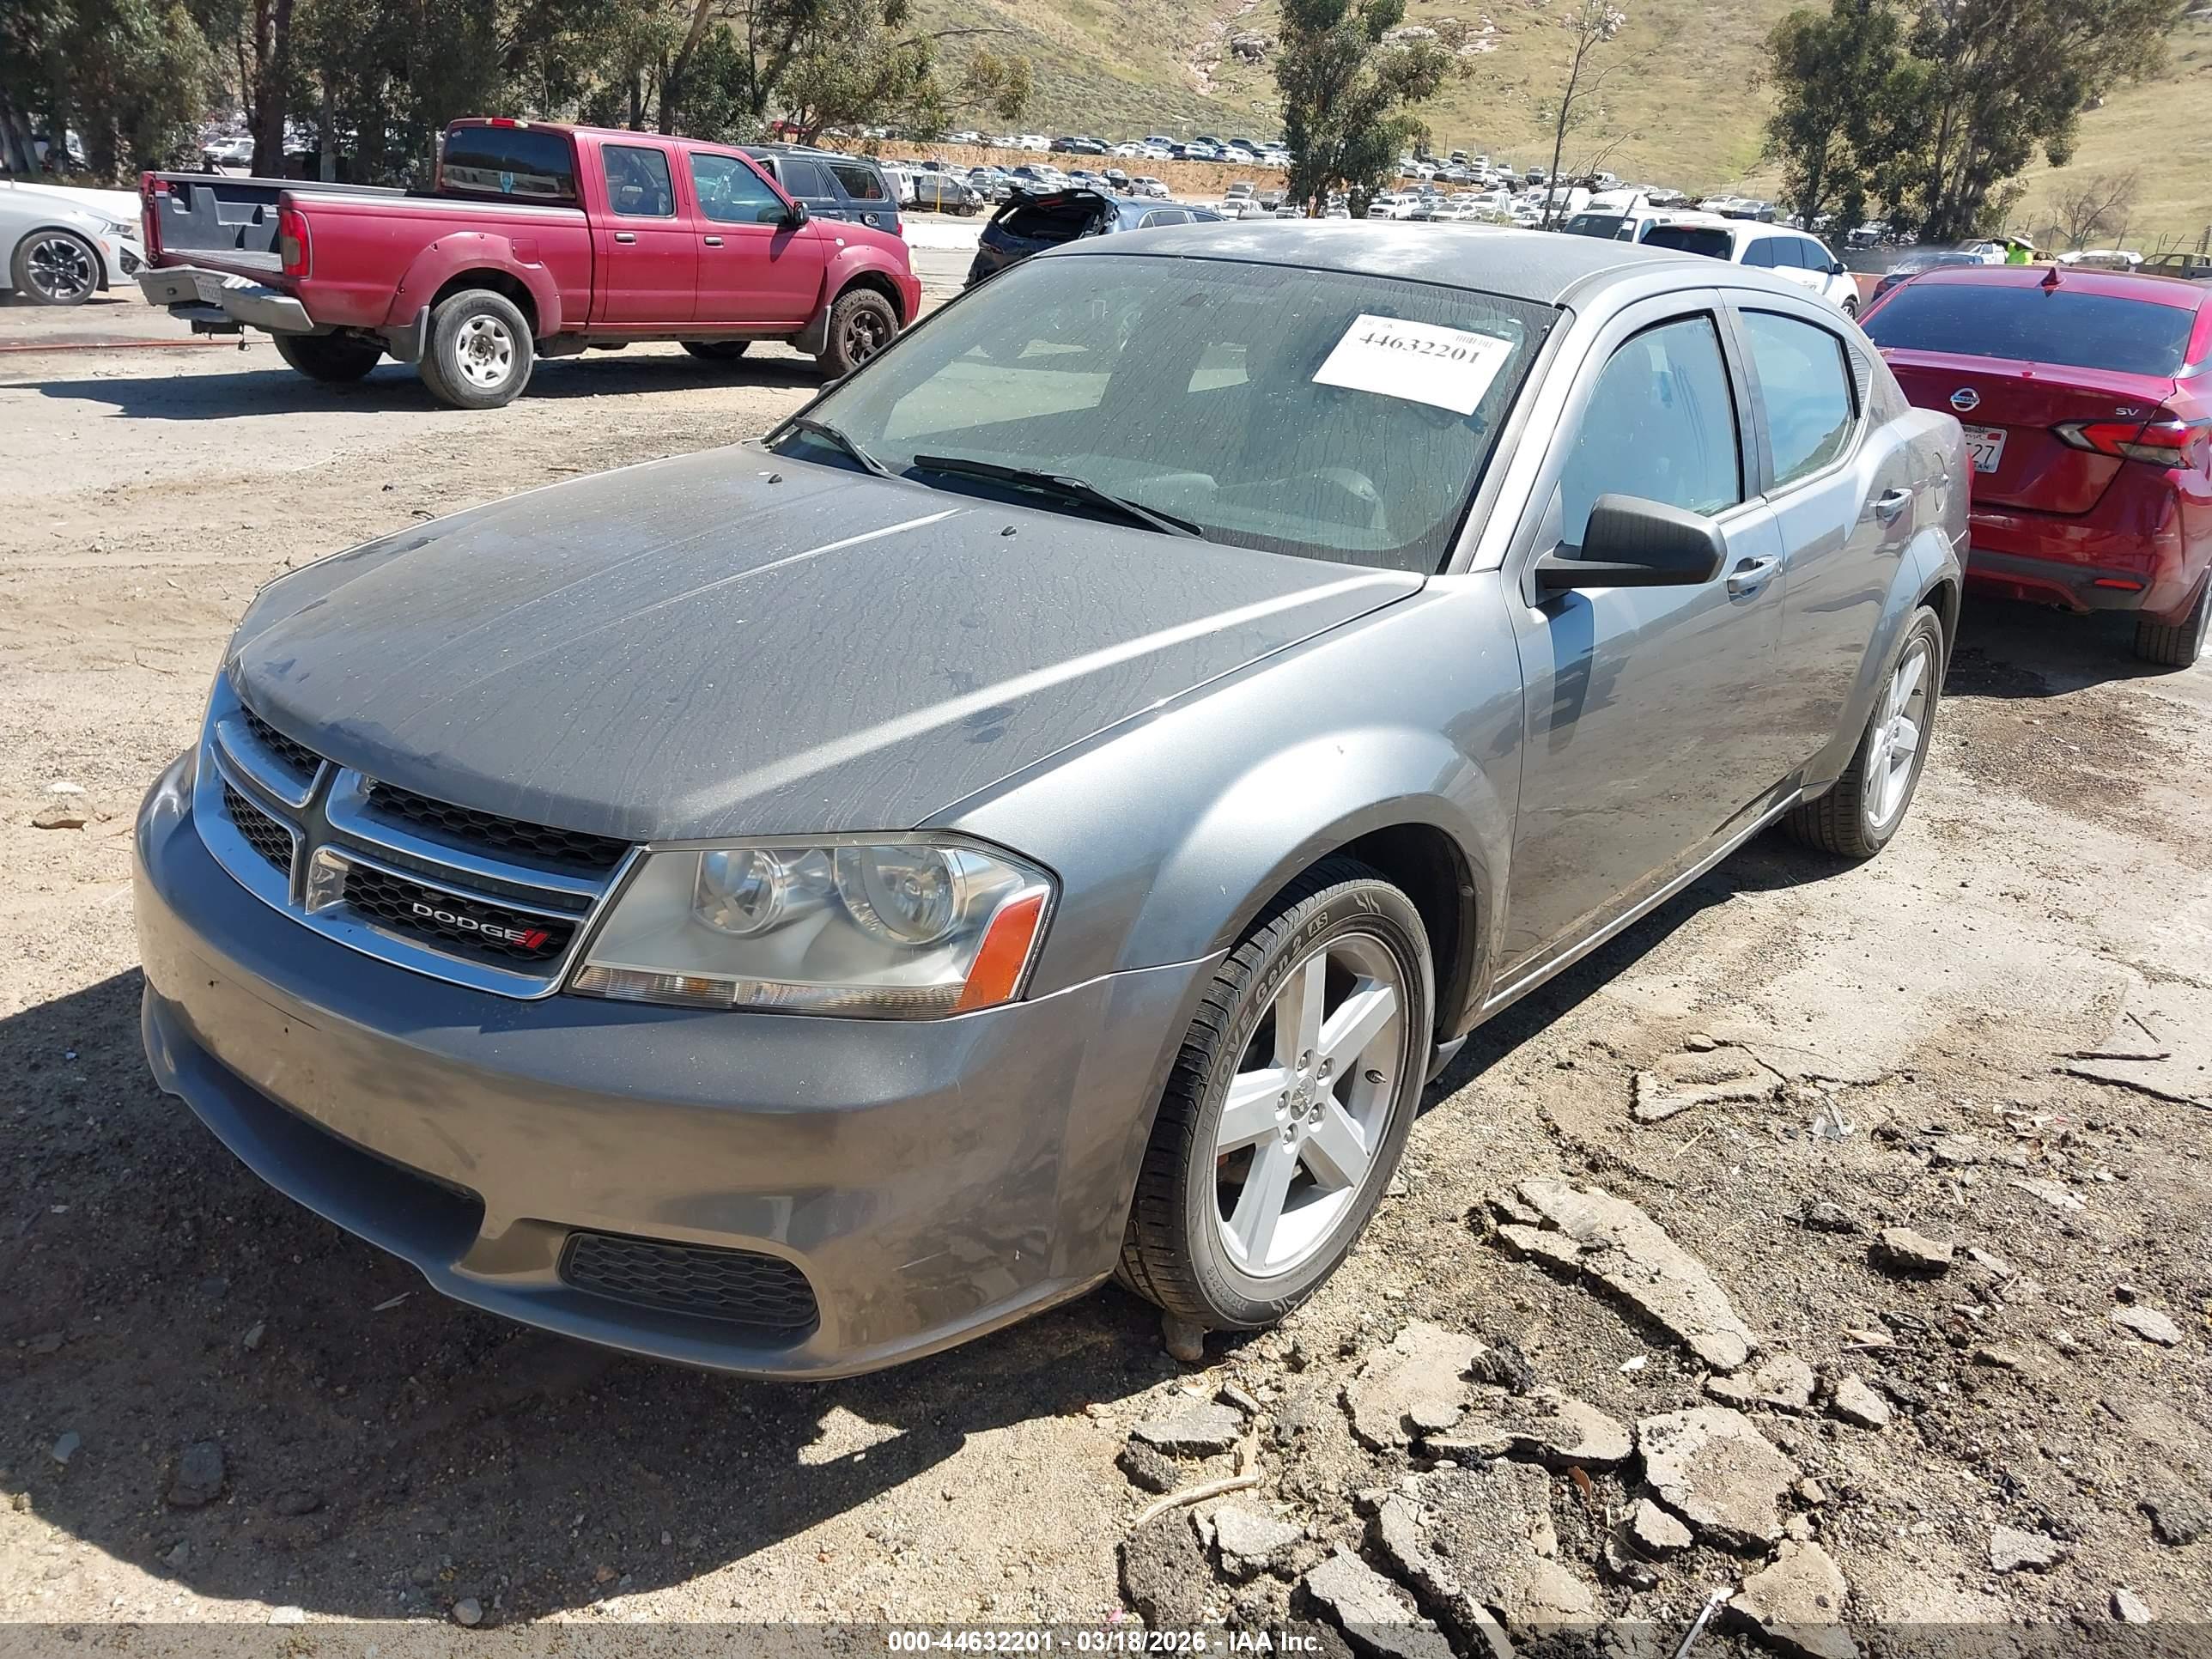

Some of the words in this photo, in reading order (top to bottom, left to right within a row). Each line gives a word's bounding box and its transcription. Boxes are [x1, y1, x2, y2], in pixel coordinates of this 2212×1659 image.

[1359, 331, 1480, 364] 44632201
[2115, 407, 2139, 416] SV
[412, 902, 527, 944] DODGE
[1255, 954, 1288, 1005] Gen
[1291, 935, 1303, 955] 2
[1309, 914, 1328, 936] AS
